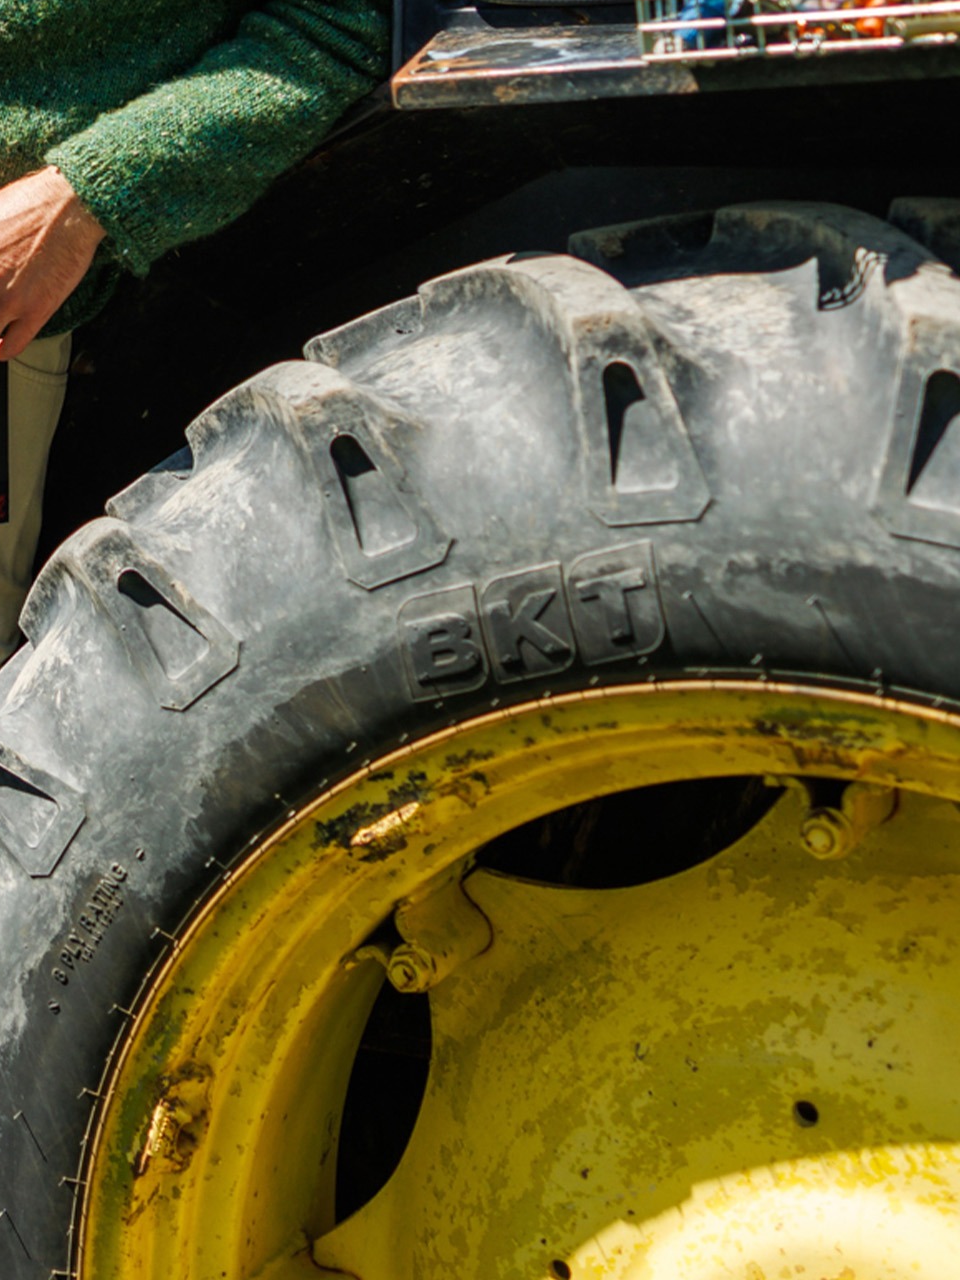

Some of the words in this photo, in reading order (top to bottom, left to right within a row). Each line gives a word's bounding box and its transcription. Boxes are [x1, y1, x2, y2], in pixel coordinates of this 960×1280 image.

[404, 569, 646, 686] BKT
[60, 928, 86, 970] PLY
[79, 862, 128, 934] RATING
